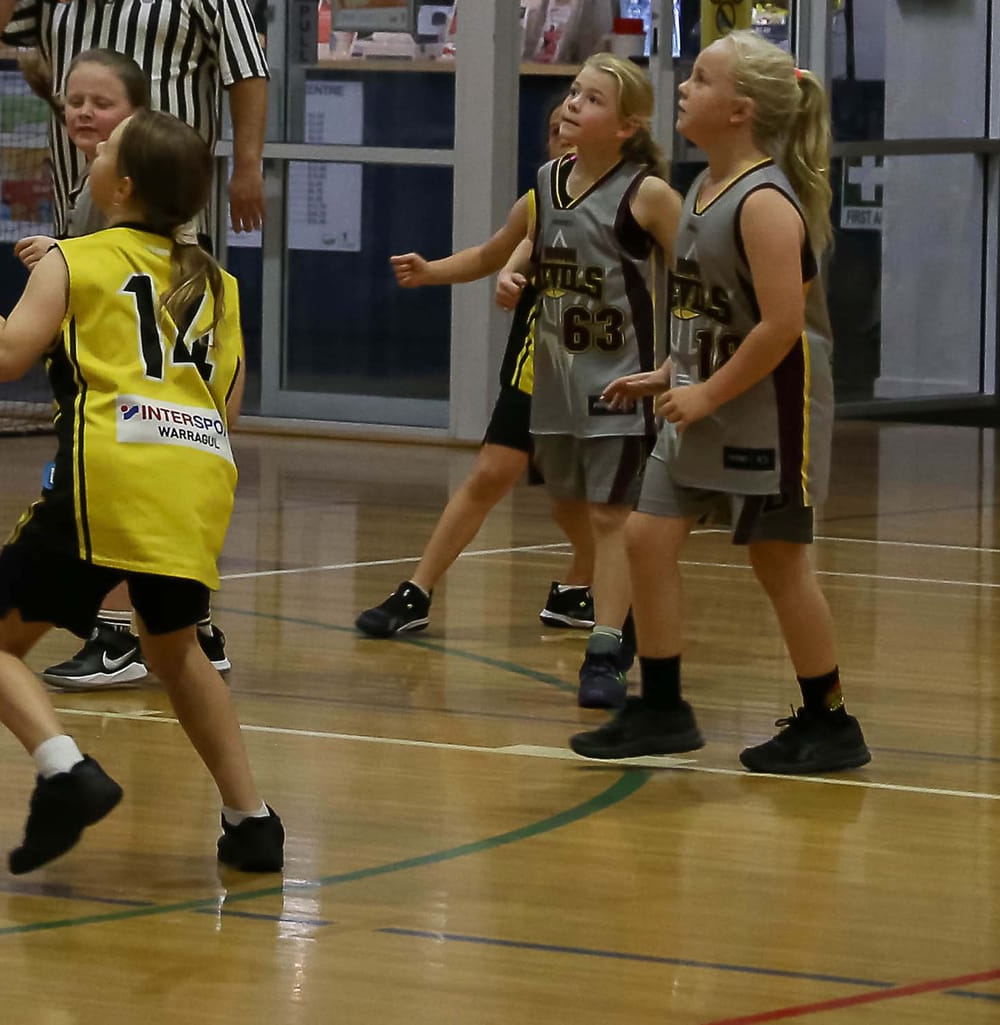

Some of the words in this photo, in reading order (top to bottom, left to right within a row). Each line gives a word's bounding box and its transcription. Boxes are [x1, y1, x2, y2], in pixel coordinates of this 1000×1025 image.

[846, 209, 872, 225] FIRST
[117, 272, 215, 383] 14
[562, 304, 625, 354] 63
[141, 403, 227, 437] INTERSPO
[158, 426, 221, 450] WARRAGUL
